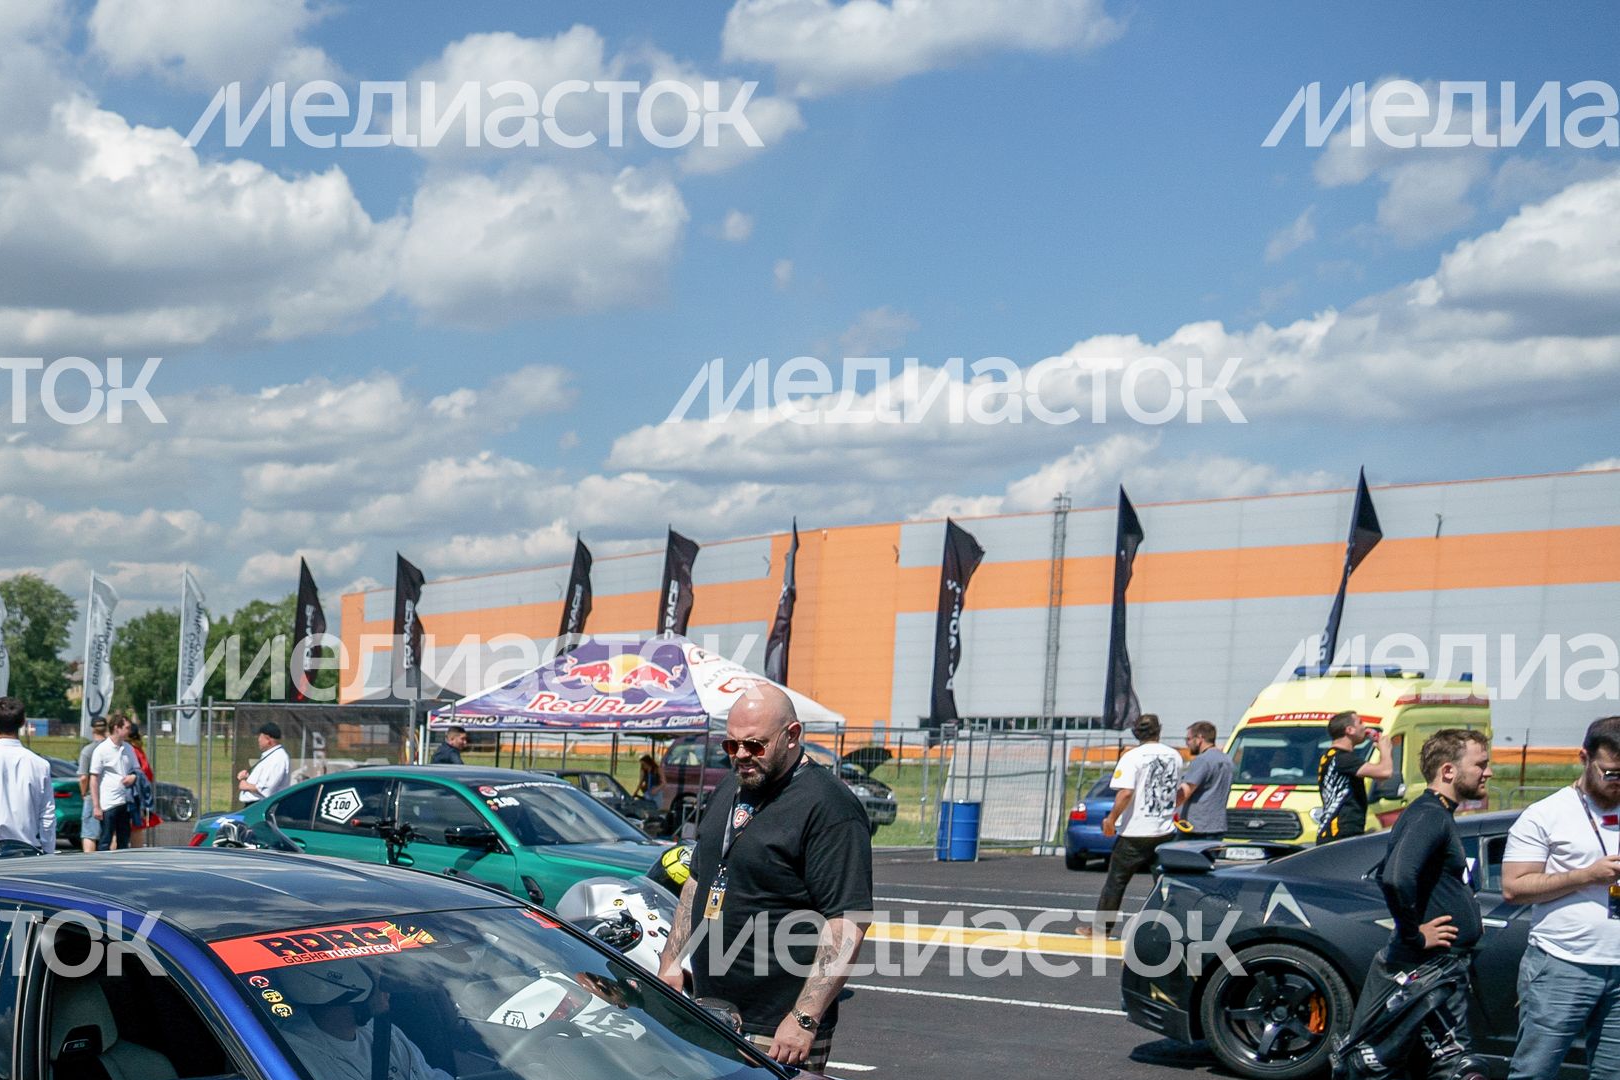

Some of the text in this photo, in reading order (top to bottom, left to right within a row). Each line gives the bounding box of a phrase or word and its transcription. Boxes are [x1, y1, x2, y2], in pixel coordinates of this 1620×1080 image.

[526, 692, 665, 715] Red Bull
[333, 800, 351, 810] 100
